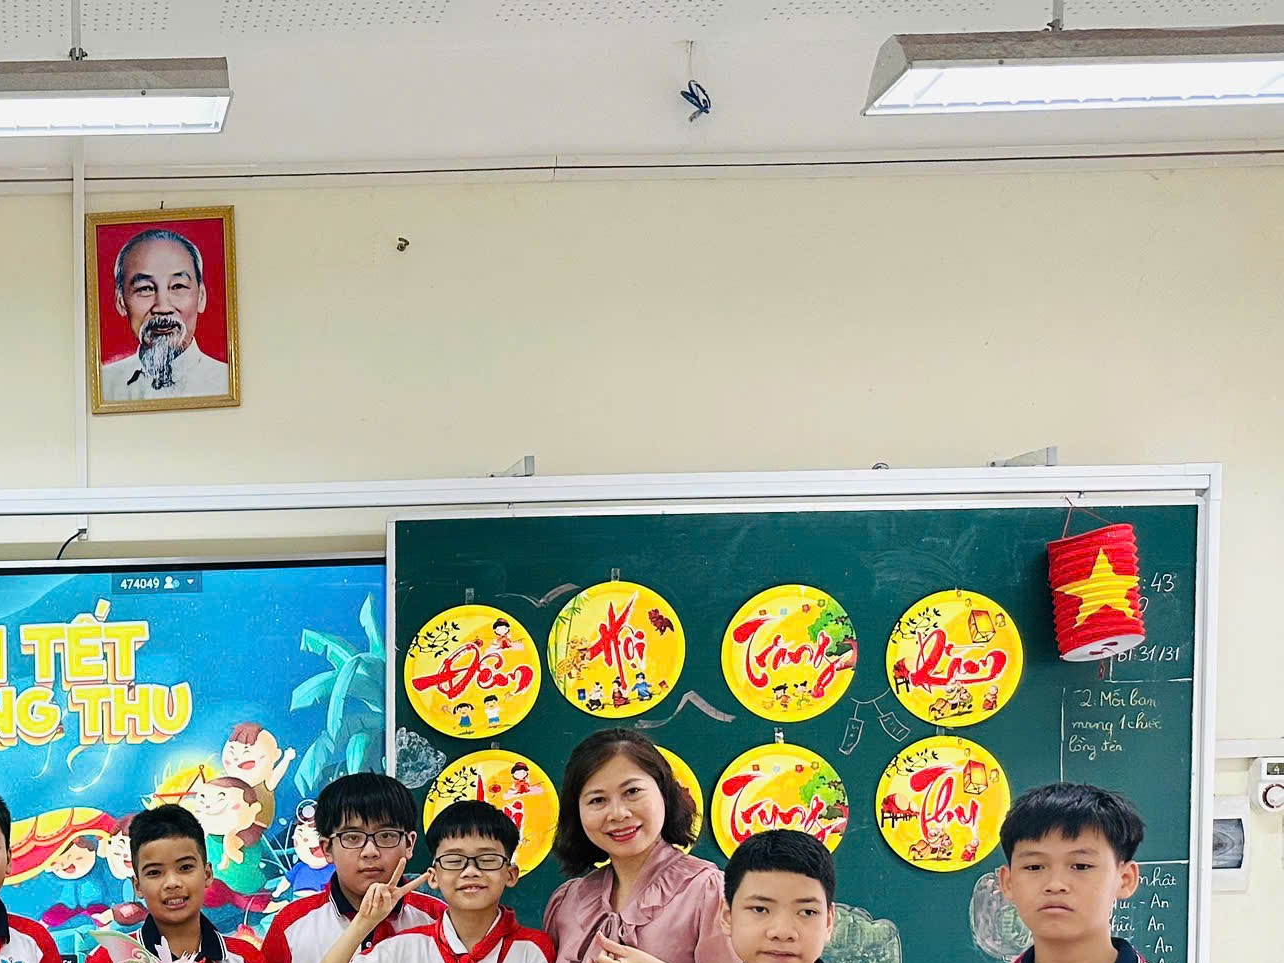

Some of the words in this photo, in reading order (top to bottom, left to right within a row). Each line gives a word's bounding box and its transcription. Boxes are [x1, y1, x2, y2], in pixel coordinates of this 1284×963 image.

[120, 577, 160, 590] 474049
[19, 598, 151, 689] TẾT
[412, 642, 534, 700] Đêm
[586, 592, 647, 691] Hội
[732, 616, 844, 698] Trăng
[910, 629, 1008, 693] Rằm
[69, 682, 193, 744] THU
[910, 765, 979, 842] Thu
